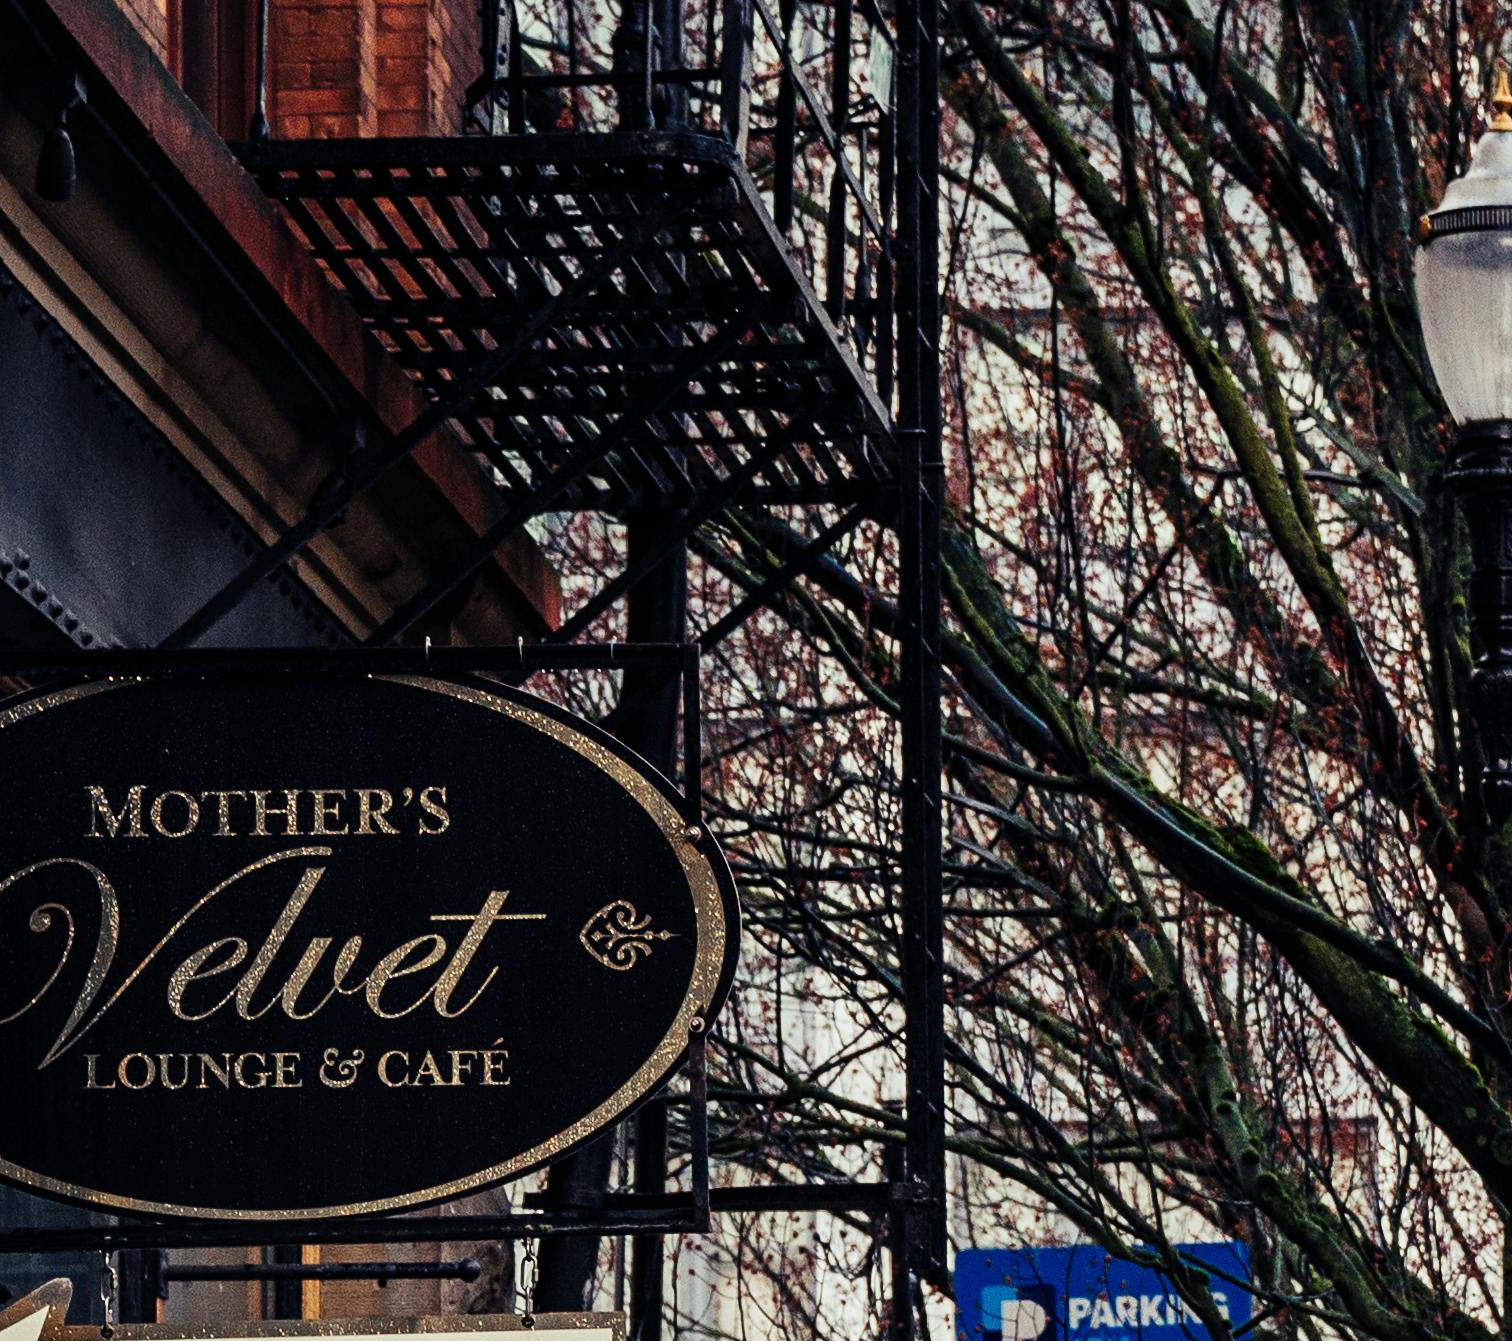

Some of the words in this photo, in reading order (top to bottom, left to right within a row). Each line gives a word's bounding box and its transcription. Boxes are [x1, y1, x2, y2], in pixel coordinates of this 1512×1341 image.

[88, 783, 451, 838] MOTHER'S
[83, 1050, 303, 1090] LOUNGE
[319, 1046, 365, 1089] &
[376, 1038, 511, 1089] CAFÉ
